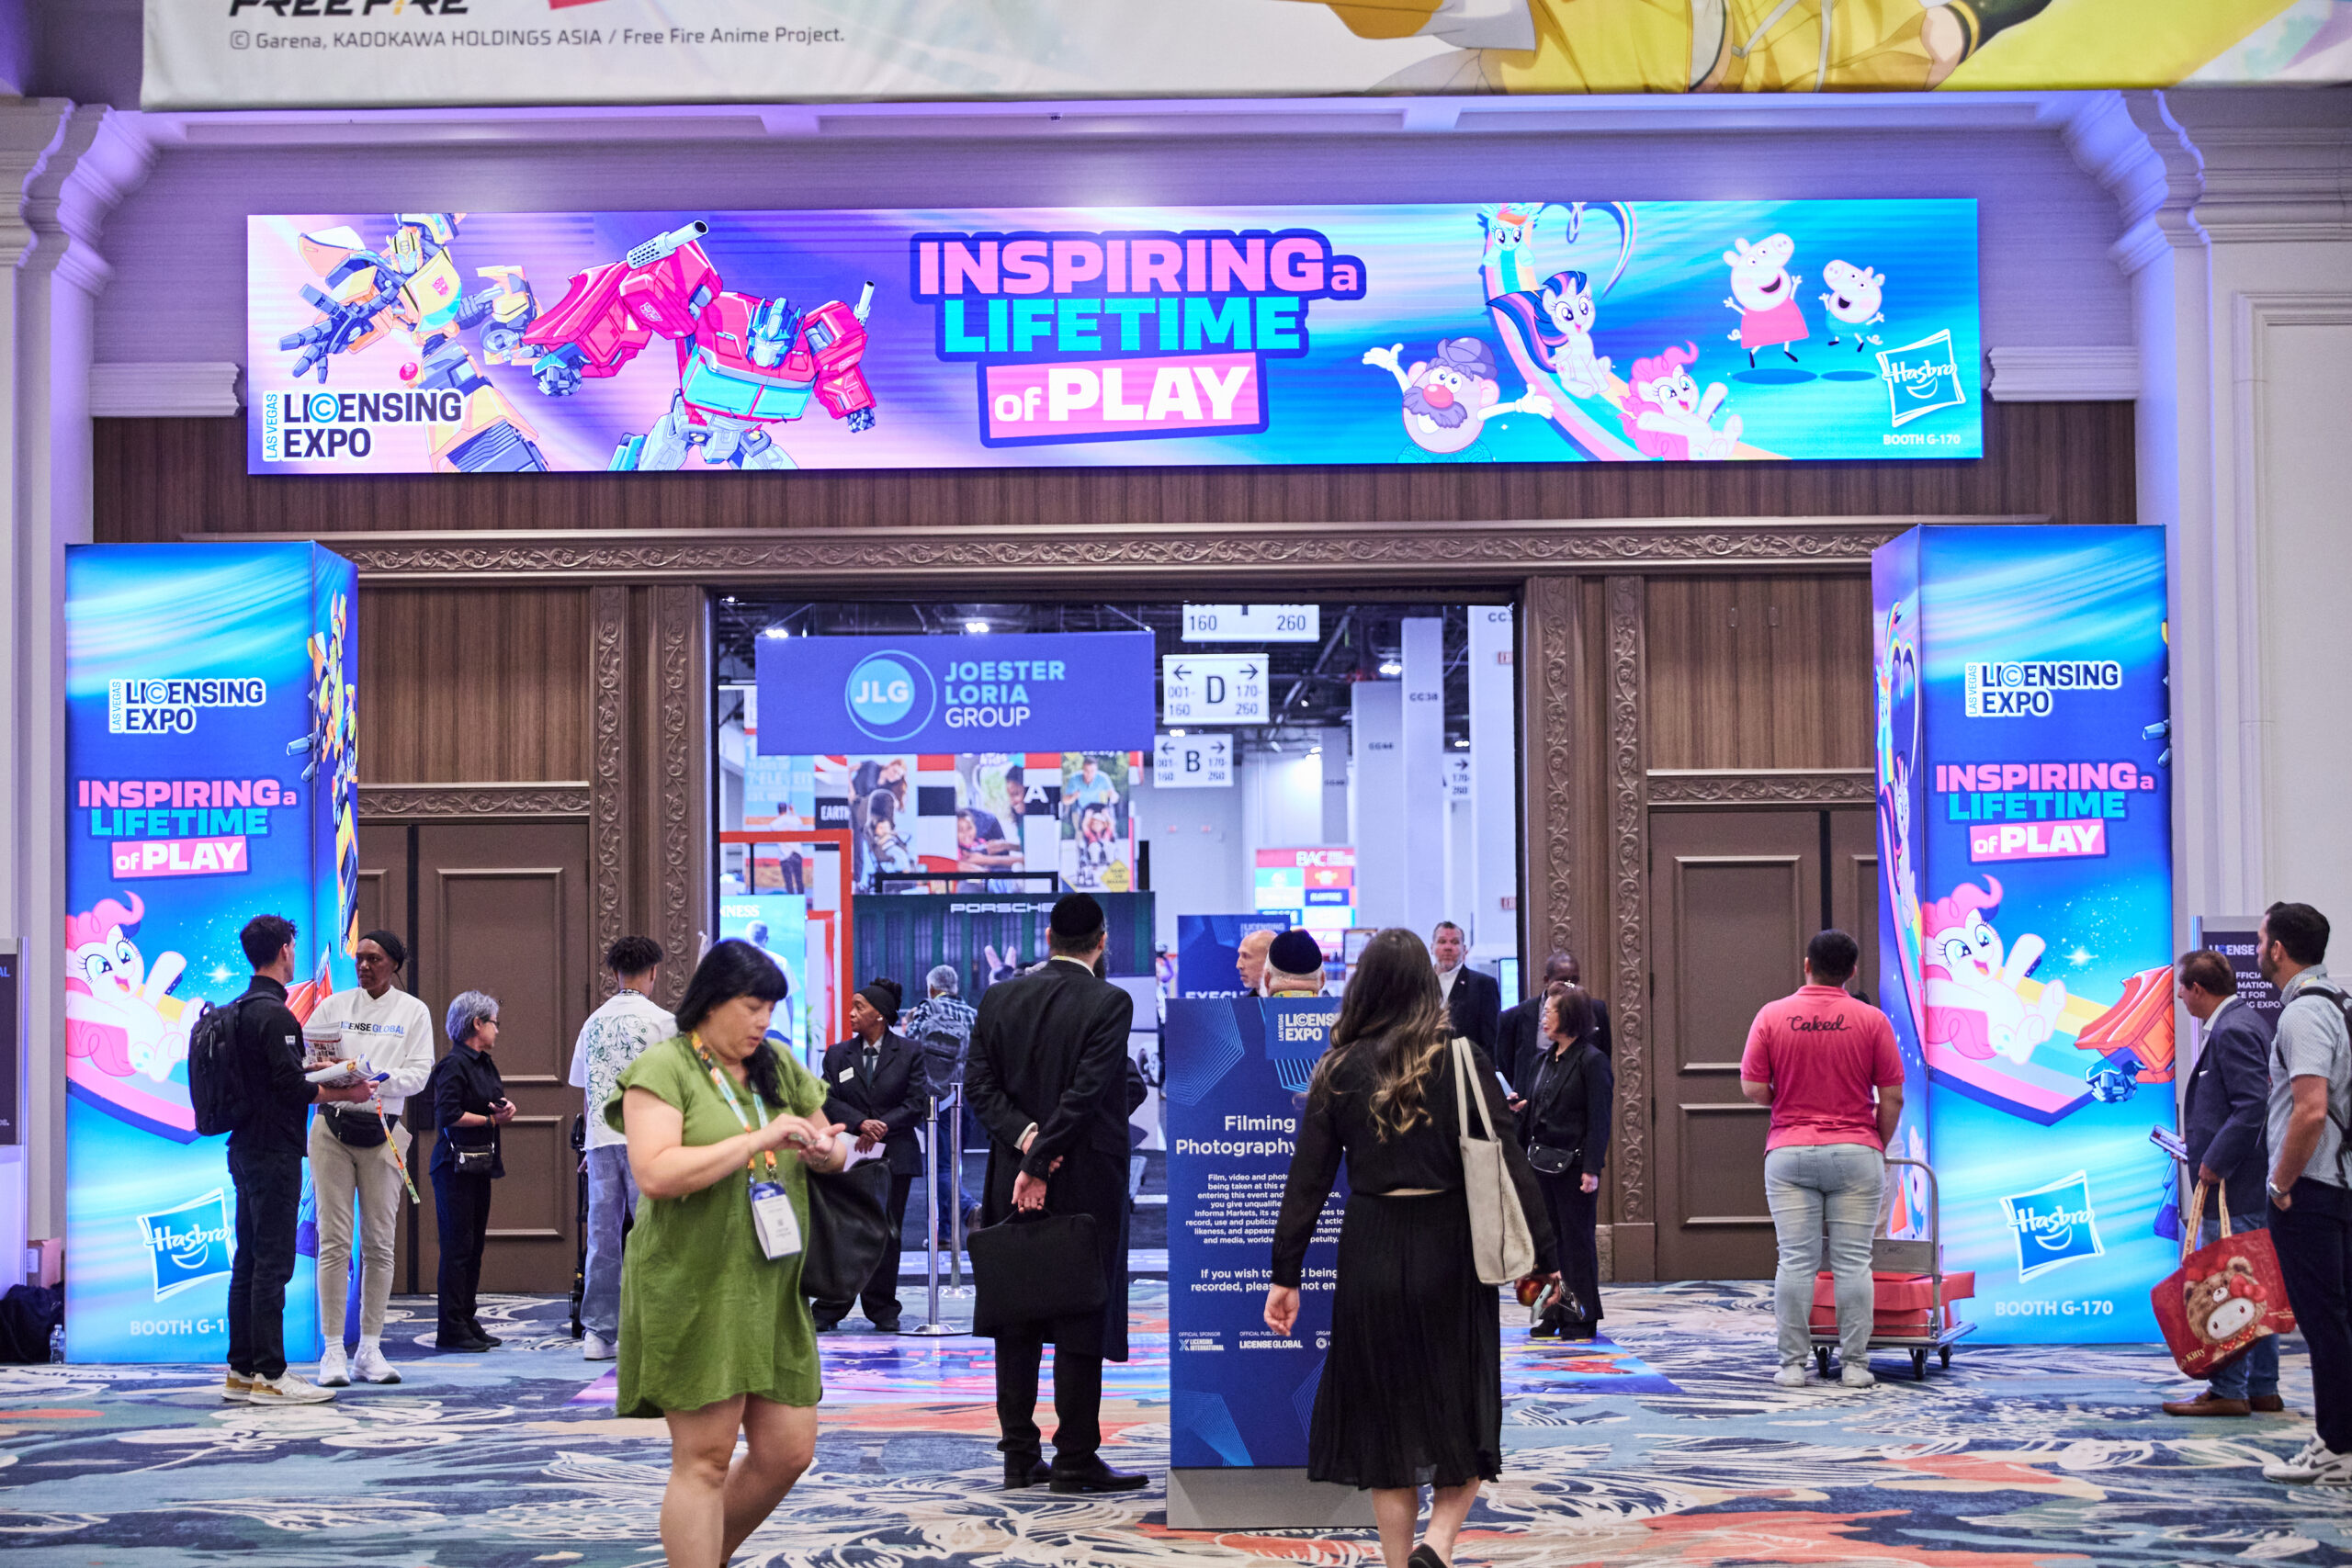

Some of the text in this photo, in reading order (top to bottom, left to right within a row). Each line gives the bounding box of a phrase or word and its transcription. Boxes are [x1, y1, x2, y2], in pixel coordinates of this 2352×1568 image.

[256, 33, 326, 51] Garena,
[334, 31, 446, 48] KADOKAWA
[452, 29, 551, 47] HOLDINGS
[557, 28, 602, 45] ASIA
[624, 28, 664, 44] Free
[670, 28, 705, 44] Fire
[710, 28, 769, 43] Anime
[775, 27, 844, 45] Project.
[920, 237, 1358, 295] INSPIRING a
[944, 297, 1300, 353] LIFETIME
[1885, 359, 1956, 384] Hasbro
[994, 367, 1250, 423] of PLAY
[266, 393, 277, 458] LAS VEGAS
[284, 428, 371, 458] EXPO
[1883, 434, 1961, 446] BOOTH G-170
[1190, 615, 1217, 631] 160
[1277, 615, 1306, 631] 260
[944, 660, 1066, 682] JOESTER
[854, 681, 909, 704] JLG
[945, 684, 1030, 705] LORIA
[1206, 675, 1226, 704] D
[1969, 665, 1977, 715] LAS VEGAS
[113, 682, 121, 731] LAS VEGAS
[1170, 705, 1191, 716] 160
[1235, 704, 1258, 715] 260
[1983, 691, 2050, 714] EXPO
[127, 708, 194, 730] EXPO
[945, 706, 1031, 728] GROUP
[1185, 750, 1201, 773] B
[1936, 762, 2154, 792] INSPIRING a
[79, 780, 297, 807] INSPIRING a
[1949, 792, 2125, 820] LIFETIME
[91, 807, 268, 836] LIFETIME
[1973, 825, 2100, 854] of PLAY
[116, 842, 243, 871] of PLAY
[720, 904, 761, 919] NNESS
[2237, 981, 2273, 989] MATION
[372, 1023, 404, 1035] GLOBAL
[1285, 1013, 1335, 1027] LICENS
[1786, 1014, 1852, 1032] Caked
[1285, 1028, 1323, 1042] EXPO
[1225, 1114, 1296, 1133] Filming
[1176, 1137, 1295, 1156] Photography
[1208, 1174, 1227, 1182] Film,
[1197, 1191, 1229, 1200] entering
[1227, 1201, 1242, 1209] give
[1244, 1201, 1282, 1209] unqualifie
[1226, 1210, 1258, 1218] Markets,
[2009, 1205, 2094, 1233] Hasbro
[145, 1224, 231, 1252] Hasbro
[1219, 1236, 1245, 1245] media,
[1310, 1235, 1340, 1244] petuity.
[1201, 1269, 1208, 1278] If
[1211, 1271, 1231, 1280] you
[1234, 1269, 1259, 1278] wish
[1308, 1269, 1337, 1280] being
[1191, 1281, 1274, 1292] recorded, pleas
[1301, 1281, 1319, 1291] not
[1995, 1300, 2114, 1316] BOOTH G-170
[130, 1318, 225, 1337] BOOTH G-1
[1272, 1340, 1304, 1348] GLOBAL
